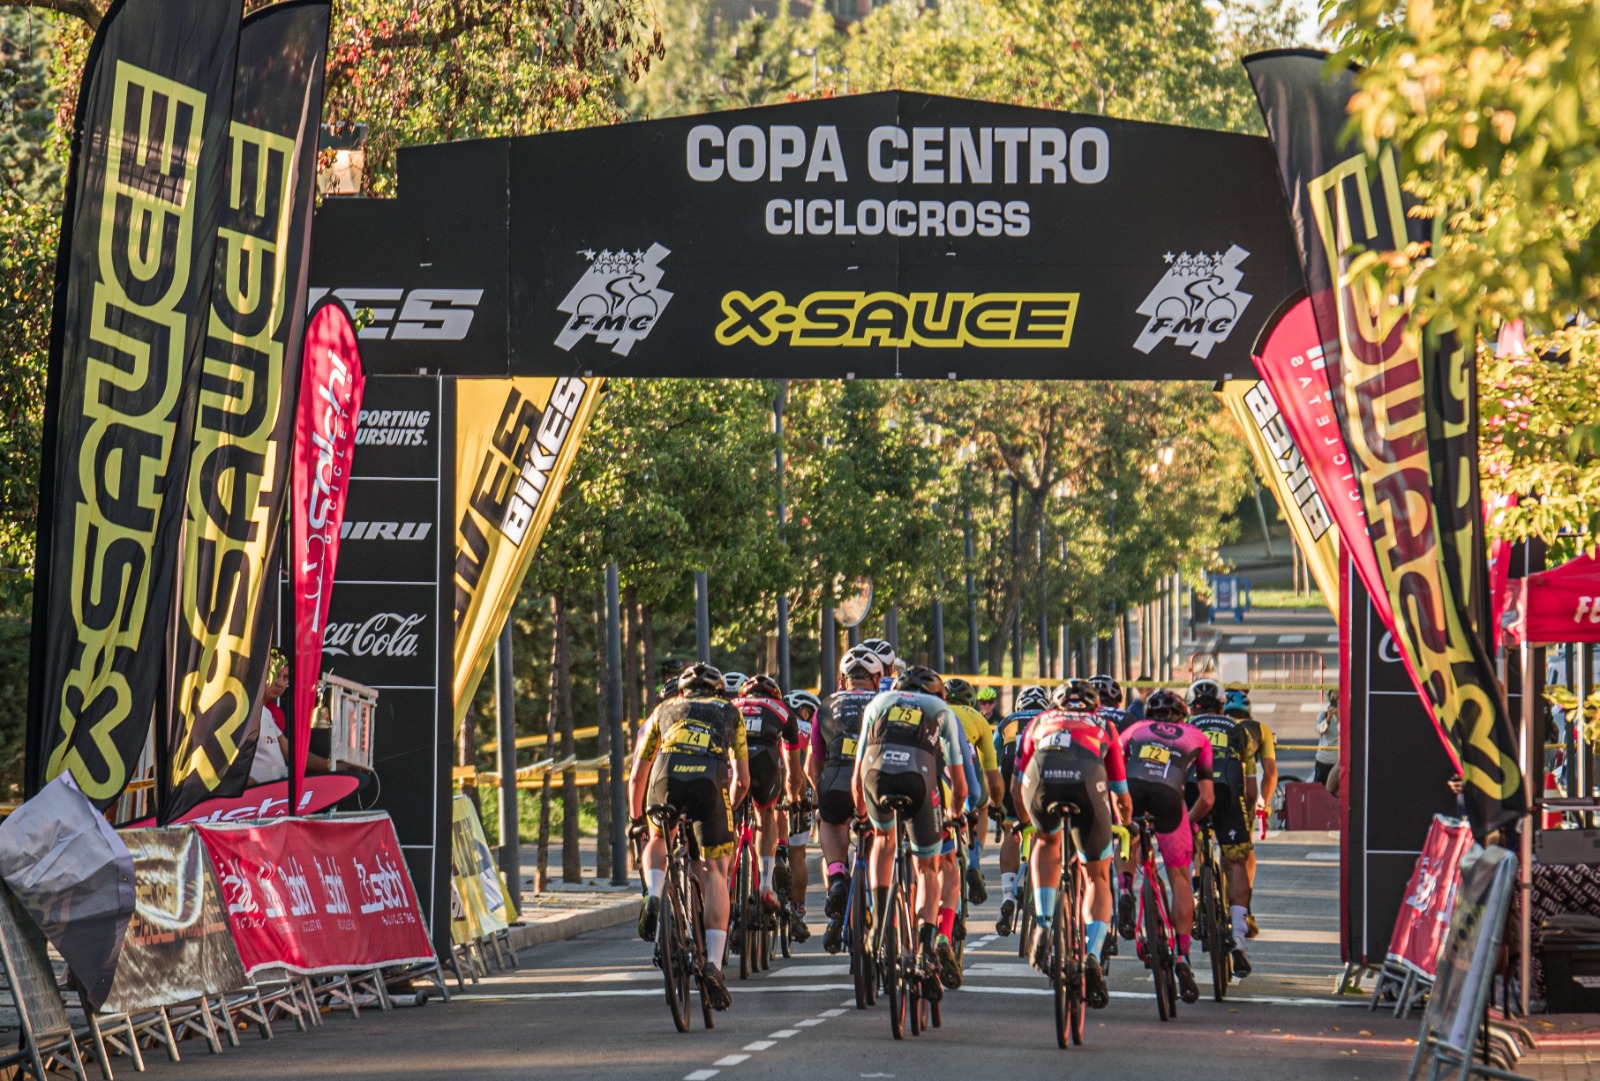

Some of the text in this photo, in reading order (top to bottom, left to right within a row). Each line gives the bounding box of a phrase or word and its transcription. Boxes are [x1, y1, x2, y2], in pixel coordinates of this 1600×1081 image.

[686, 124, 1110, 185] COPA CENTRO
[765, 198, 1031, 237] CICLOCROSS
[569, 315, 654, 331] FMC
[715, 290, 1081, 348] X-SAUCE
[1149, 317, 1232, 334] FMC
[46, 59, 207, 800] X-SAUCE
[358, 410, 431, 427] PORTING
[355, 428, 428, 446] URSUITS.
[172, 121, 296, 792] X-SAUCE
[325, 373, 353, 545] BICICLETAS
[502, 378, 587, 547] BIKES
[322, 612, 427, 657] ca-Cola
[899, 708, 912, 721] 75
[686, 731, 700, 744] 74
[1208, 732, 1219, 745] 71
[882, 750, 910, 761] CCB
[1150, 746, 1161, 760] 72
[1536, 876, 1567, 902] mitto
[1556, 876, 1588, 905] mitto
